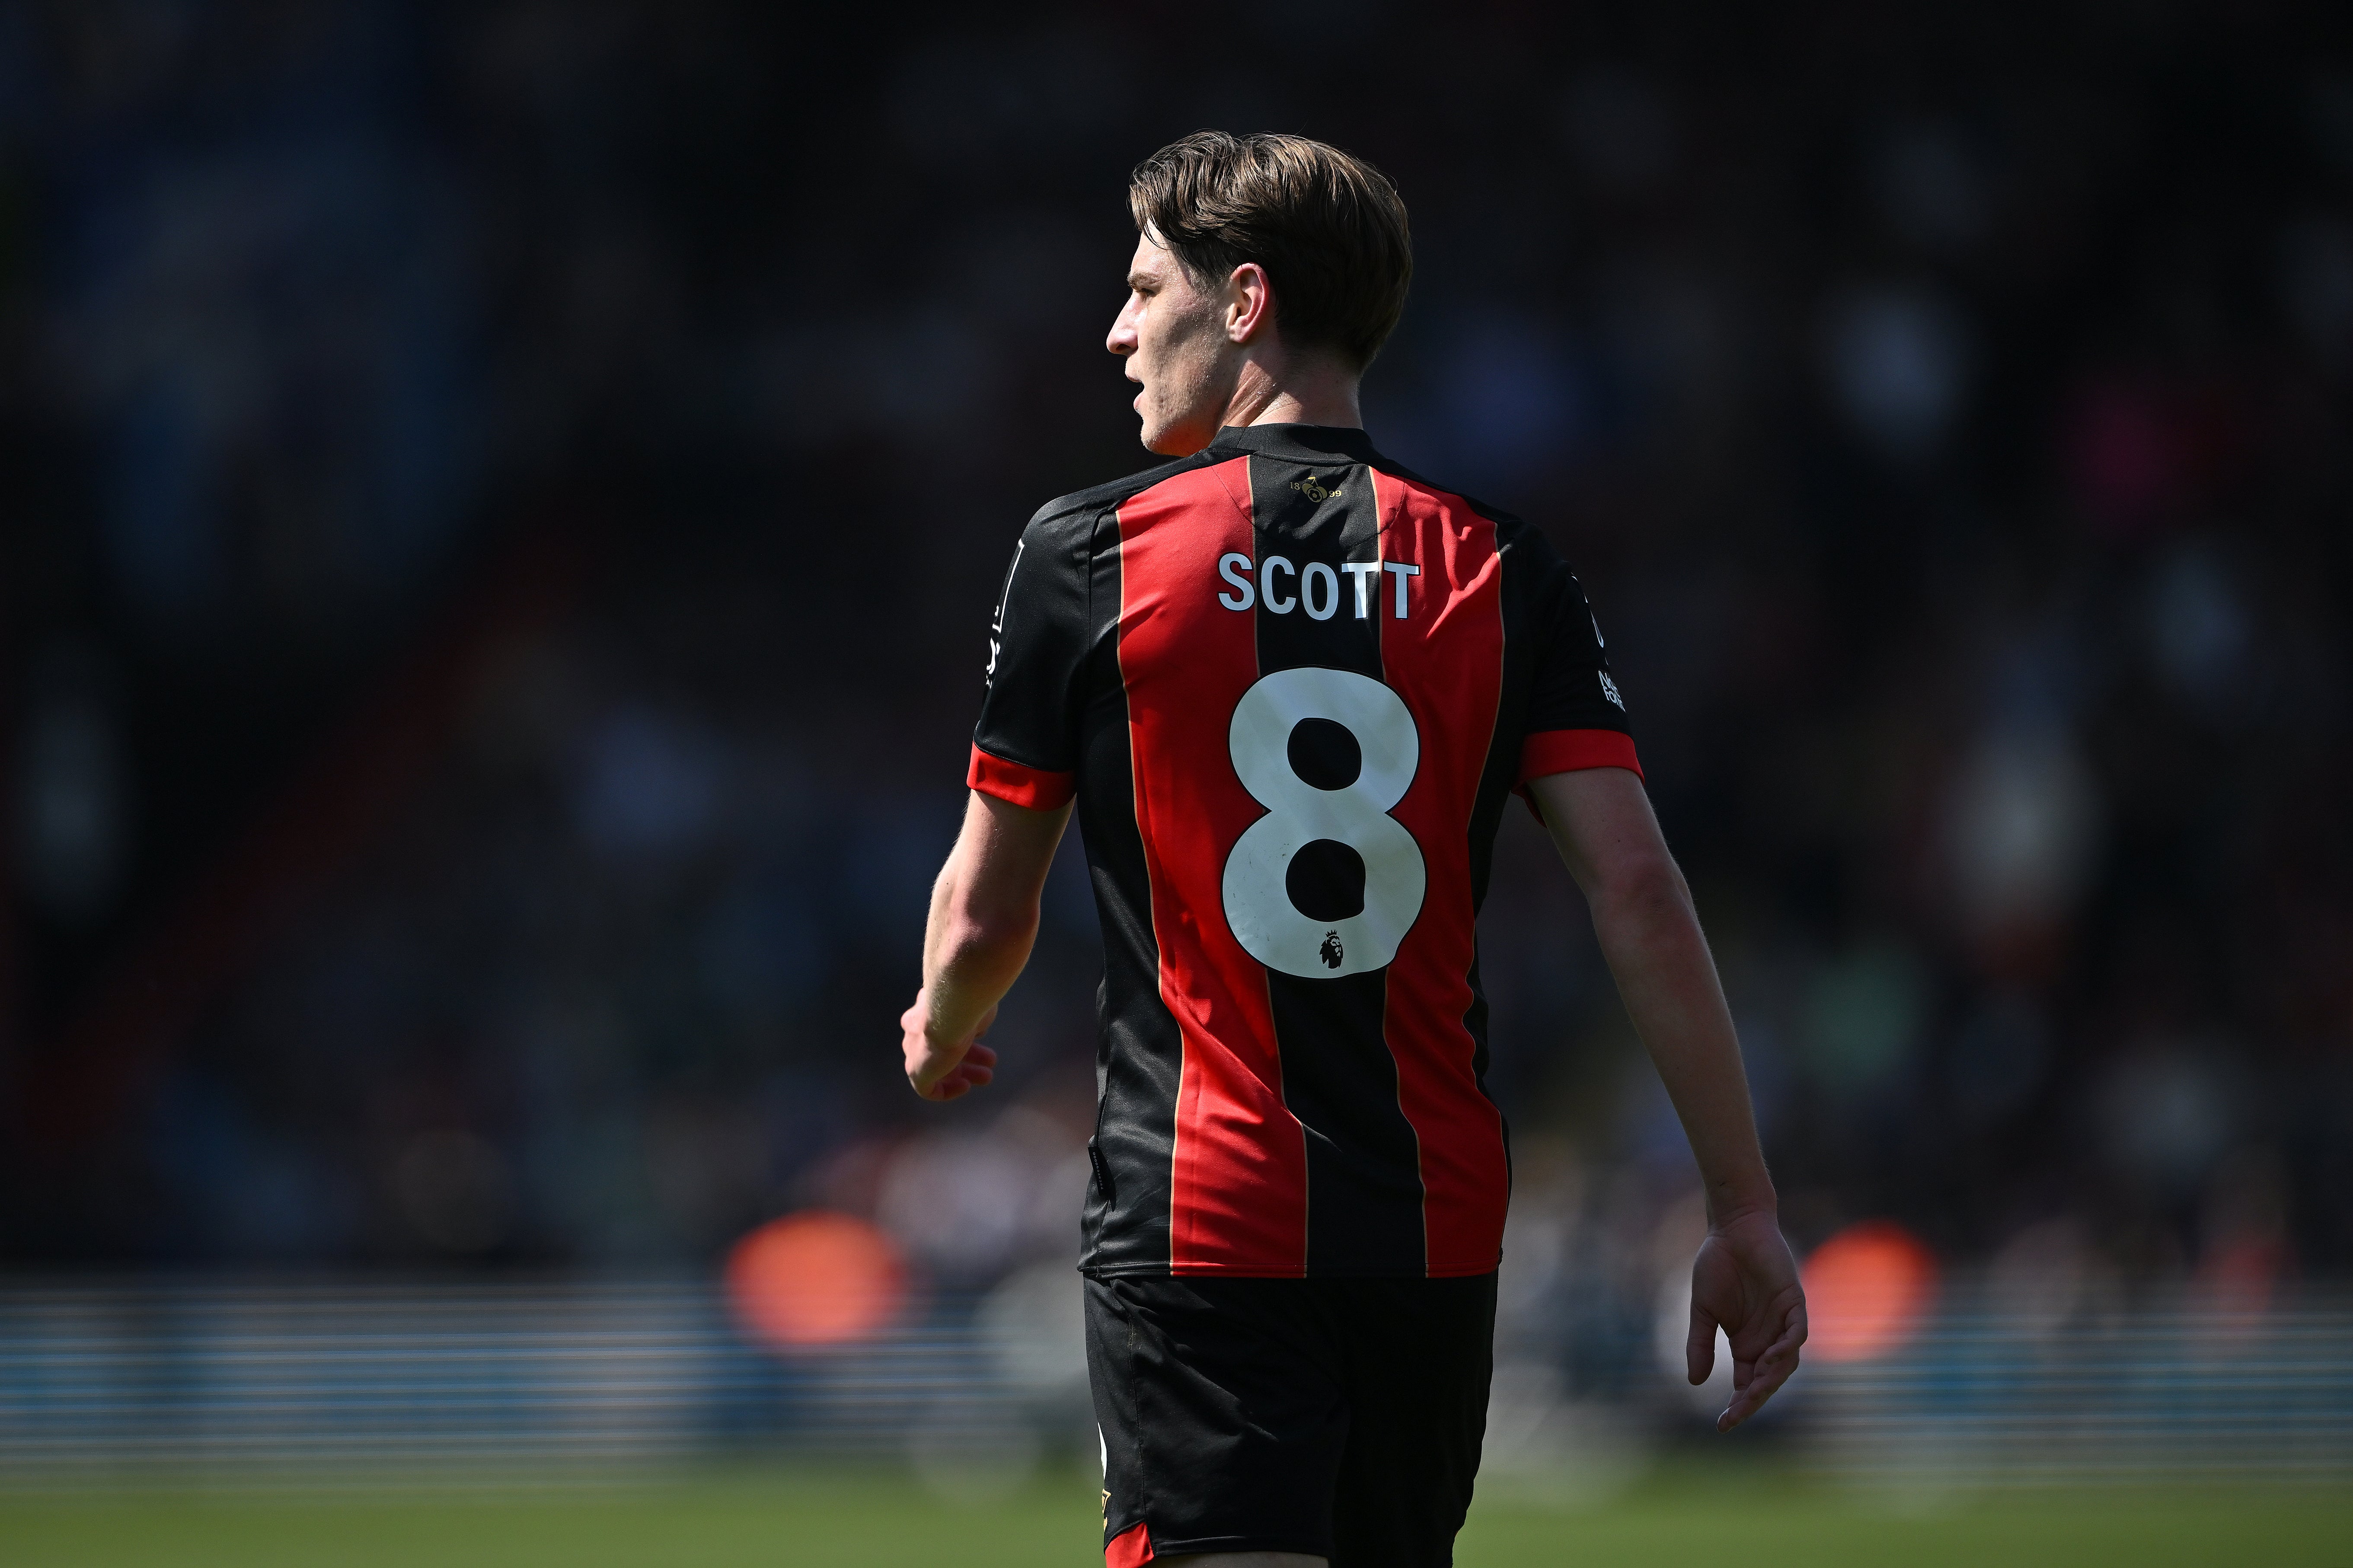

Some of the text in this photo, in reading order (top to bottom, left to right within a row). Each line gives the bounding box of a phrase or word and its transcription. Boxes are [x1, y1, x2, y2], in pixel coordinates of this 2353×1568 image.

[1290, 482, 1300, 490] 18
[1218, 552, 1421, 621] SCOTT
[1222, 667, 1426, 979] 8
